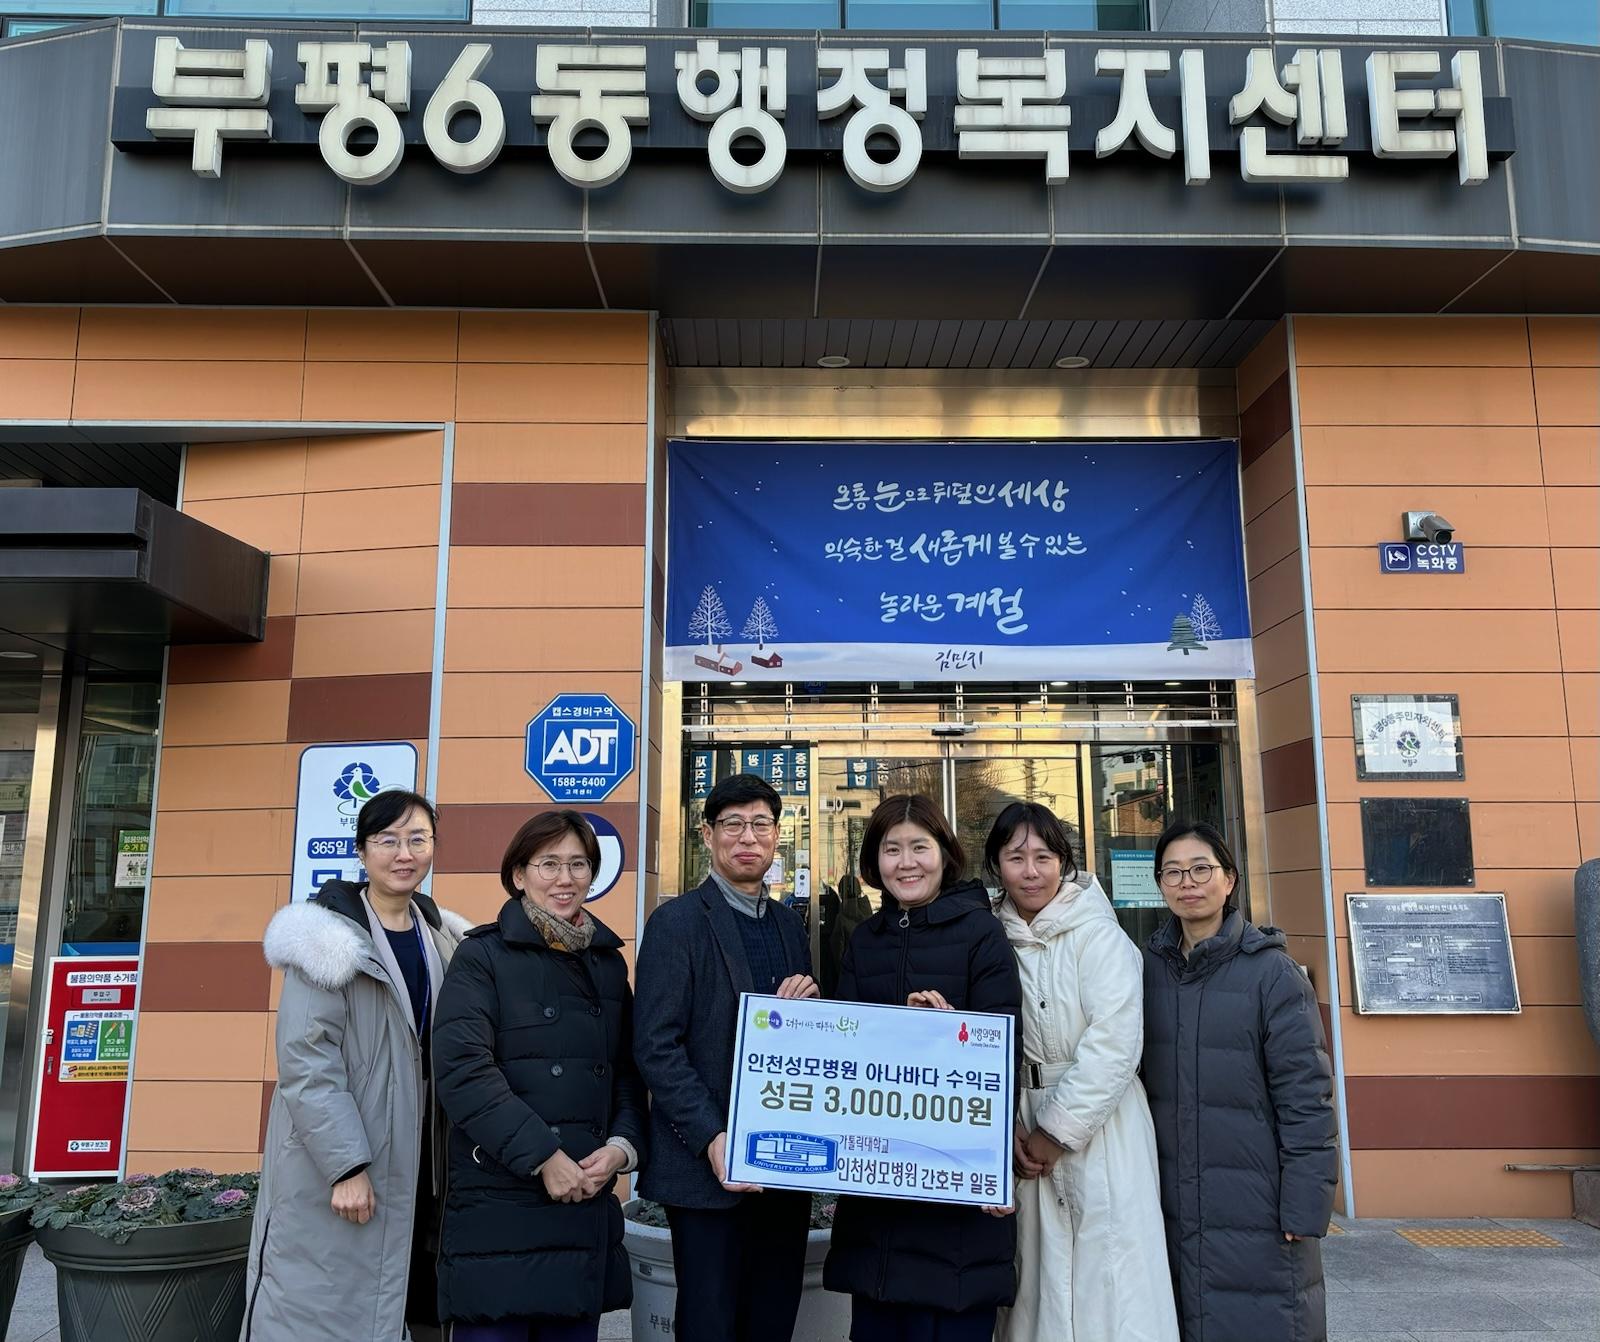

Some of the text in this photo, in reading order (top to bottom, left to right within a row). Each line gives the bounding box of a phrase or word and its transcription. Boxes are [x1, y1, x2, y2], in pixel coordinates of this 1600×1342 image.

[145, 36, 1489, 194] 부평6동행정복지센터
[833, 479, 1070, 512] 온통 눈으로 뒤덮인 세상
[824, 529, 1088, 566] 익숙한 걸 새롭게 볼 수 있는
[1416, 544, 1457, 556] CCTV
[1417, 557, 1458, 570] 녹화중
[880, 587, 1029, 635] 놀라운 계절
[935, 649, 983, 672] 김민지
[552, 706, 613, 717] 캡스경비구역
[544, 728, 618, 765] ADT
[552, 777, 606, 787] 1588-6400
[340, 817, 358, 831] 부평
[311, 840, 348, 855] 365일
[747, 1053, 1001, 1092] 인천성모병원 아나바다 수익금
[760, 1080, 992, 1127] 성금 3,000,000원
[839, 1134, 889, 1154] 가톨릭대학교
[753, 1159, 793, 1172] UNIVERSITY
[837, 1157, 998, 1197] 인천성모병원 간호부 일동
[650, 1312, 671, 1334] 부평
